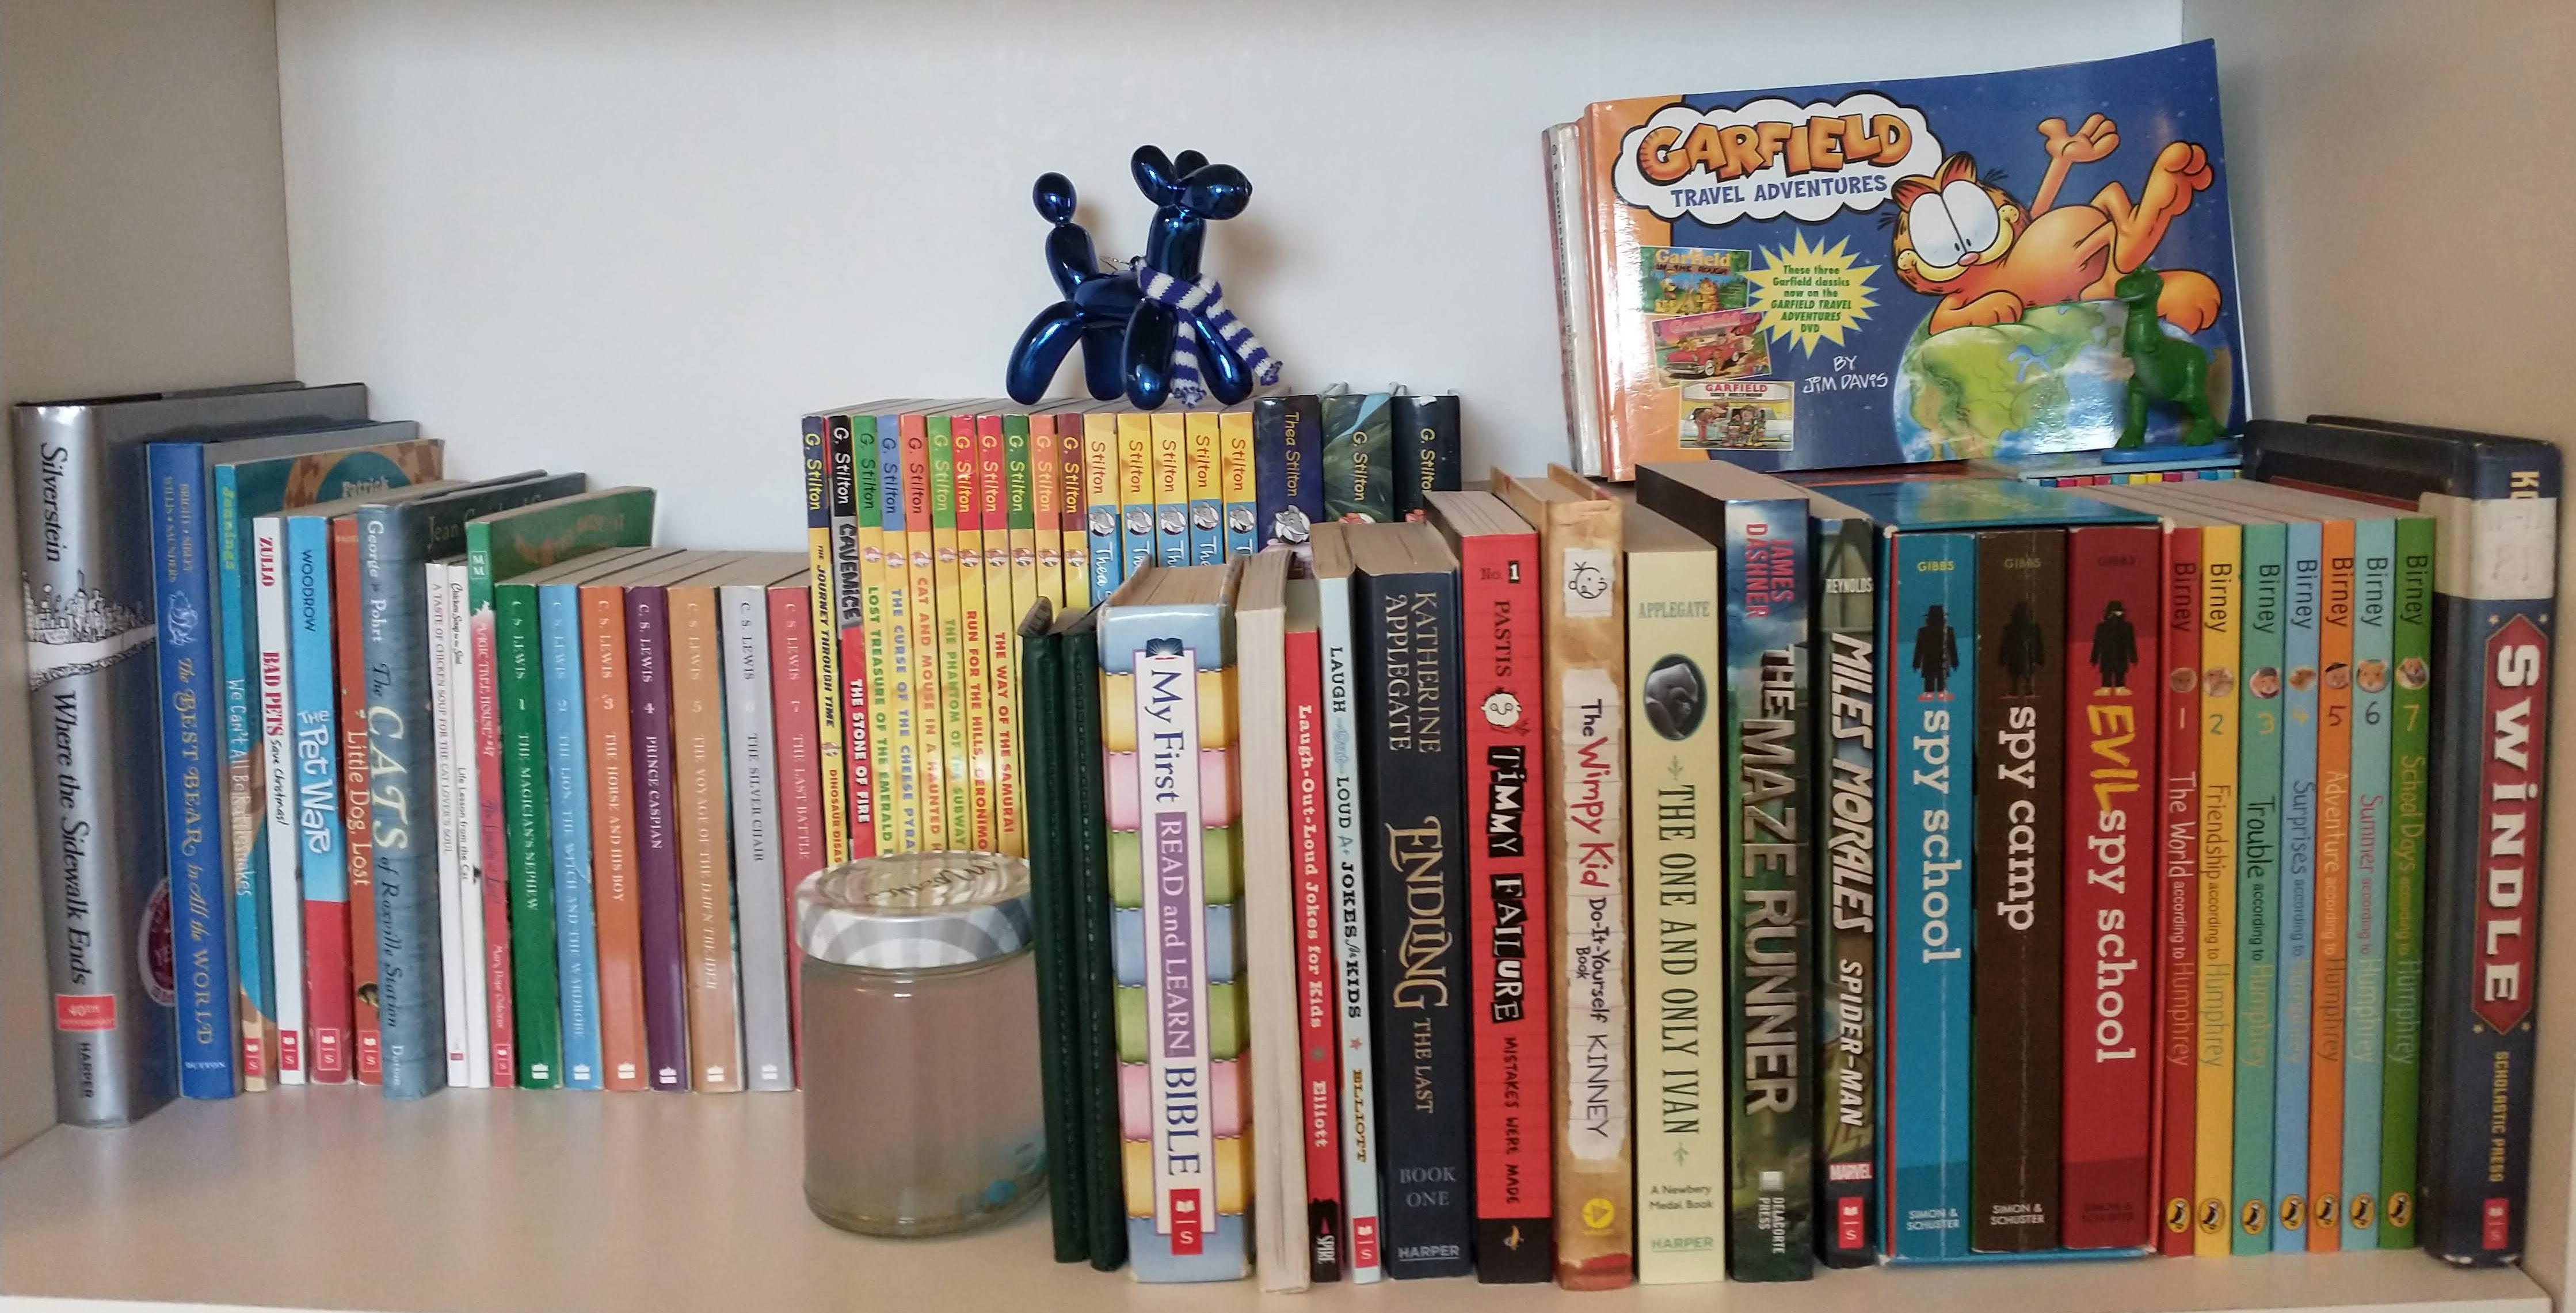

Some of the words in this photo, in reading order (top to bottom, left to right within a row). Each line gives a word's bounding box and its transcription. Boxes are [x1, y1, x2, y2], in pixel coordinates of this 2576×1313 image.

[1636, 113, 1912, 186] GARFIELD
[1670, 186, 1745, 207] TRAVEL
[1755, 174, 1888, 201] ADVENTURES
[1773, 276, 1812, 287] Garfield
[1815, 277, 1850, 286] classics
[1784, 265, 1811, 274] These
[1813, 265, 1839, 274] three
[1823, 289, 1838, 297] the
[1771, 299, 1815, 309] GARFIELD
[1818, 300, 1851, 309] TRAVEL
[1781, 312, 1840, 321] ADVENTURES
[1801, 323, 1820, 333] DVD
[1705, 384, 1767, 392] GARFIELD
[1833, 355, 1857, 372] BY
[806, 433, 820, 450] G.
[834, 428, 849, 444] G.
[40, 443, 68, 562] Silverstein
[807, 459, 824, 510] Stilton
[836, 452, 851, 504] Stilton
[260, 537, 275, 587] ZULLO
[1095, 541, 1112, 587] Thea
[1746, 524, 1768, 619] DASHNER
[1771, 540, 1794, 602] JAMES
[1918, 562, 1954, 571] GIBBS
[301, 551, 315, 632] WOODROW
[1639, 601, 1710, 619] APPLEGATE
[2171, 562, 2196, 632] Birney
[2204, 563, 2232, 633] Birney
[370, 599, 386, 642] Pohrt
[996, 633, 1006, 658] THE
[1495, 601, 1512, 677] PASTIS
[177, 658, 194, 683] The
[263, 652, 280, 686] BAD
[374, 663, 391, 696] The
[513, 635, 526, 679] LEWIS
[997, 666, 1008, 698] WAY
[1386, 594, 1411, 750] APPLEGATE
[1411, 591, 1441, 753] KATHERINE
[1762, 644, 1795, 712] THE
[226, 679, 246, 700] We
[265, 692, 283, 736] PETS
[851, 679, 862, 706] THE
[999, 706, 1009, 724] OF
[1144, 669, 1183, 723] My
[1831, 633, 1873, 748] MILES
[55, 690, 78, 766] Where
[173, 689, 199, 761] BEST
[229, 702, 249, 746] Can't
[852, 712, 866, 760] STONE
[1000, 731, 1011, 756] THE
[1582, 699, 1603, 737] The
[230, 748, 250, 769] All
[271, 740, 282, 765] Save
[298, 726, 330, 773] Pet
[346, 731, 368, 783] Little
[519, 733, 529, 760] THE
[646, 736, 660, 786] PRINCE
[748, 733, 758, 761] THE
[793, 734, 804, 762] THE
[1153, 730, 1184, 803] First
[1913, 710, 1950, 794] spy
[1998, 707, 2037, 788] spy
[2087, 705, 2140, 813] EVIL
[59, 773, 79, 808] the
[232, 775, 251, 793] Be
[275, 768, 288, 827] Christmas!
[367, 706, 410, 850] CATS
[750, 767, 761, 815] SILVER
[795, 768, 807, 802] LAST
[829, 770, 840, 827] DINOSAUR
[856, 766, 868, 785] OF
[1002, 764, 1014, 833] SAMURAI
[1298, 705, 1318, 875] Laugh-Out-Loud
[1569, 737, 1612, 835] Wimpy
[1742, 720, 1796, 877] MAZE
[2169, 772, 2196, 812] The
[181, 767, 203, 856] BEAR
[348, 789, 371, 835] Dog,
[521, 768, 535, 848] MAGICIAN'S
[649, 791, 662, 849] CASPIAN
[796, 806, 810, 860] BATTLE
[858, 792, 870, 823] FIRE
[1657, 785, 1696, 842] THE
[2201, 784, 2231, 879] Friendship
[231, 794, 254, 896] Rattlesnakes
[353, 843, 371, 886] Lost
[378, 857, 392, 875] of
[753, 820, 764, 861] CHAIR
[1160, 820, 1184, 895] READ
[1577, 842, 1615, 888] Kid
[1827, 758, 1873, 933] MORALES
[1996, 799, 2037, 930] camp
[2087, 810, 2127, 894] spy
[2167, 822, 2196, 877] World
[62, 816, 91, 919] Sidewalk
[188, 865, 205, 879] in
[524, 852, 539, 911] NEPHEW
[1659, 853, 1697, 906] ONE
[1922, 810, 1963, 964] school
[190, 883, 209, 915] All
[381, 882, 401, 957] Roxville
[1305, 882, 1320, 939] Jokes
[1385, 816, 1453, 1010] ENDLING
[2170, 882, 2185, 942] according
[2205, 883, 2221, 944] according
[191, 920, 209, 941] the
[1163, 905, 1187, 946] and
[1493, 876, 1524, 1021] FAILURE
[1660, 920, 1698, 976] AND
[68, 926, 93, 984] Ends
[1308, 945, 1321, 975] for
[1576, 946, 1592, 980] Book
[1588, 898, 1611, 1024] Do-It-Yourself
[2173, 948, 2187, 959] to
[2209, 948, 2221, 960] to
[193, 949, 213, 1045] WORLD
[386, 963, 398, 1027] Station
[1167, 959, 1190, 1049] LEARN
[1309, 981, 1322, 1028] Kids
[1744, 890, 1797, 1117] RUNNER
[2096, 909, 2137, 1063] school
[1412, 1018, 1432, 1059] THE
[1661, 988, 1699, 1066] ONLY
[2166, 963, 2194, 1066] Humphrey
[2201, 963, 2231, 1067] Humphrey
[1840, 960, 1864, 1126] SPIDER-MAN
[1414, 1066, 1434, 1114] LAST
[1503, 1036, 1519, 1108] MISTAKES
[1587, 1034, 1610, 1138] KINNEY
[2491, 1051, 2509, 1133] SCHOLASTIC
[1165, 1067, 1201, 1175] BIBLE
[1313, 1081, 1327, 1147] Elliott
[1353, 1068, 1367, 1163] ELLIOTT
[1662, 1068, 1699, 1135] IVAN
[1504, 1117, 1520, 1154] WERE
[2489, 1138, 2505, 1181] PRESS
[1399, 1166, 1455, 1183] BOOK
[1406, 1192, 1449, 1207] ONE
[1506, 1163, 1519, 1205] MADE
[1663, 1185, 1712, 1194] Newbery
[1772, 1197, 1785, 1253] DELACORTE
[1907, 1219, 1960, 1230] SCHUSTER
[1990, 1215, 2044, 1226] SCHUSTER
[1398, 1245, 1460, 1258] HARPER
